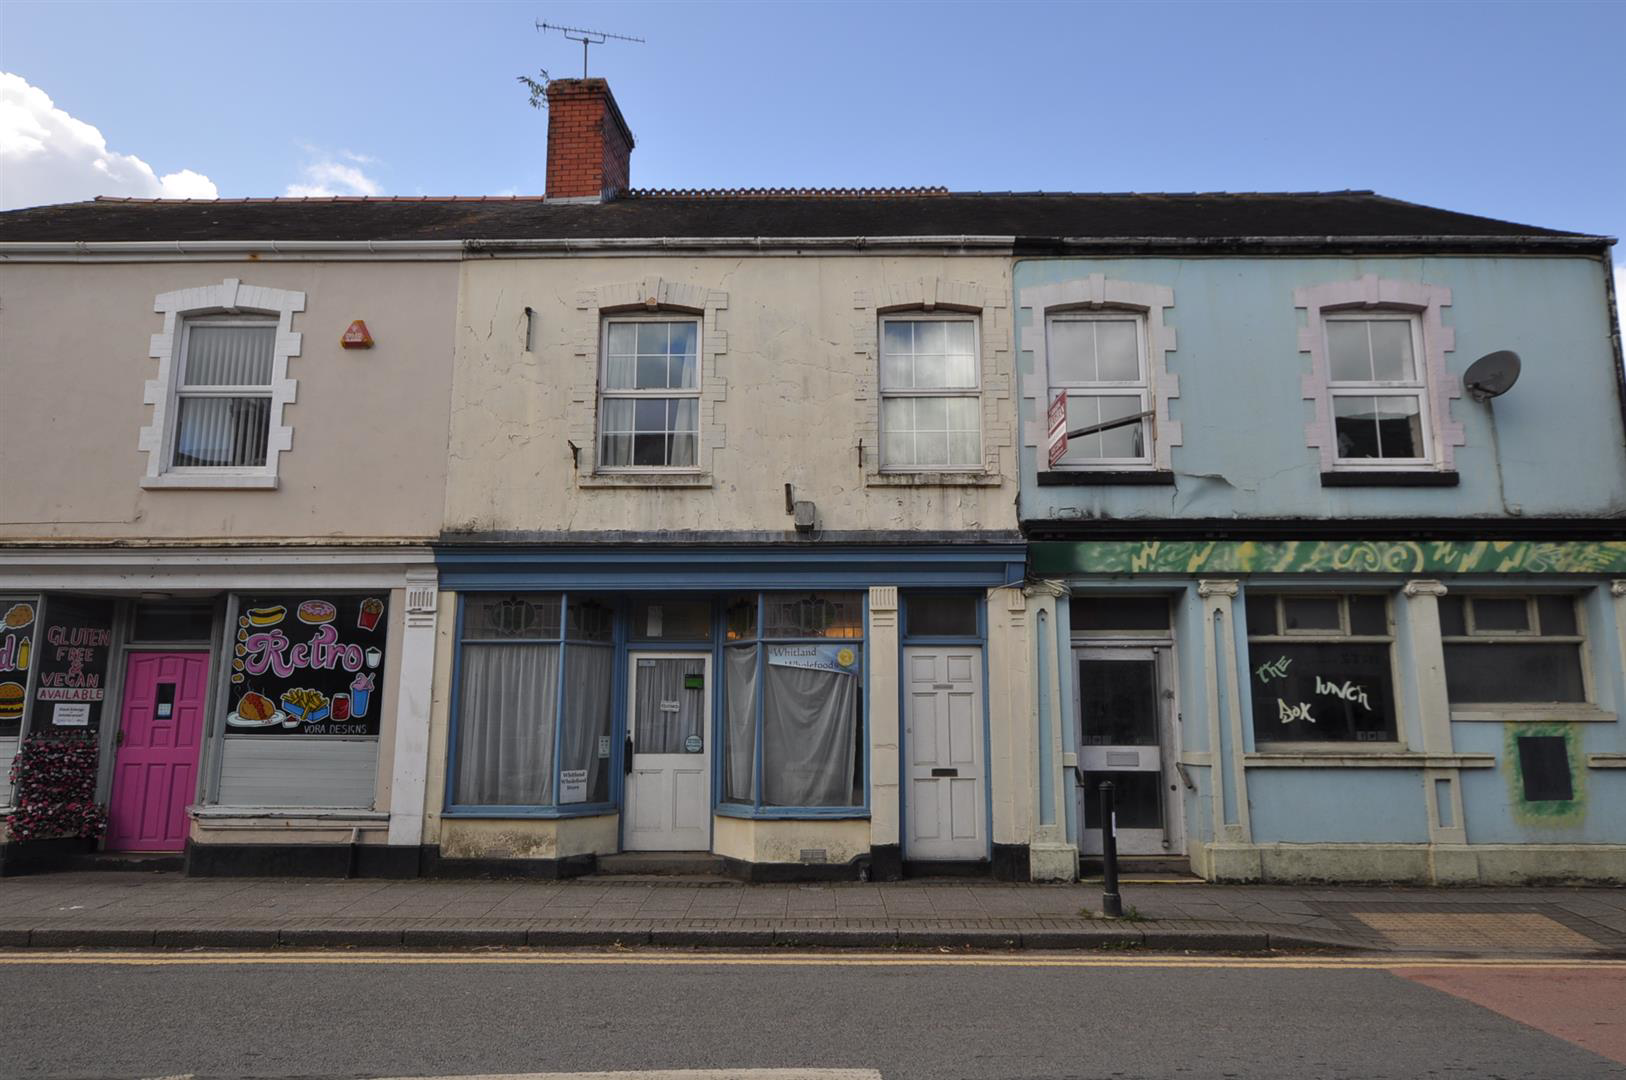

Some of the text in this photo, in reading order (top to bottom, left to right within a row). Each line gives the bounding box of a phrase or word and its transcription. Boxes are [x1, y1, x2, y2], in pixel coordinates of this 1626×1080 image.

[47, 625, 112, 647] GLUTEN
[56, 646, 95, 662] FREE
[245, 624, 364, 678] Retro
[773, 647, 817, 657] Whitland
[41, 671, 100, 688] VEGAN
[39, 689, 104, 700] AVAILABLE
[304, 724, 367, 734] VORA DESIGNS
